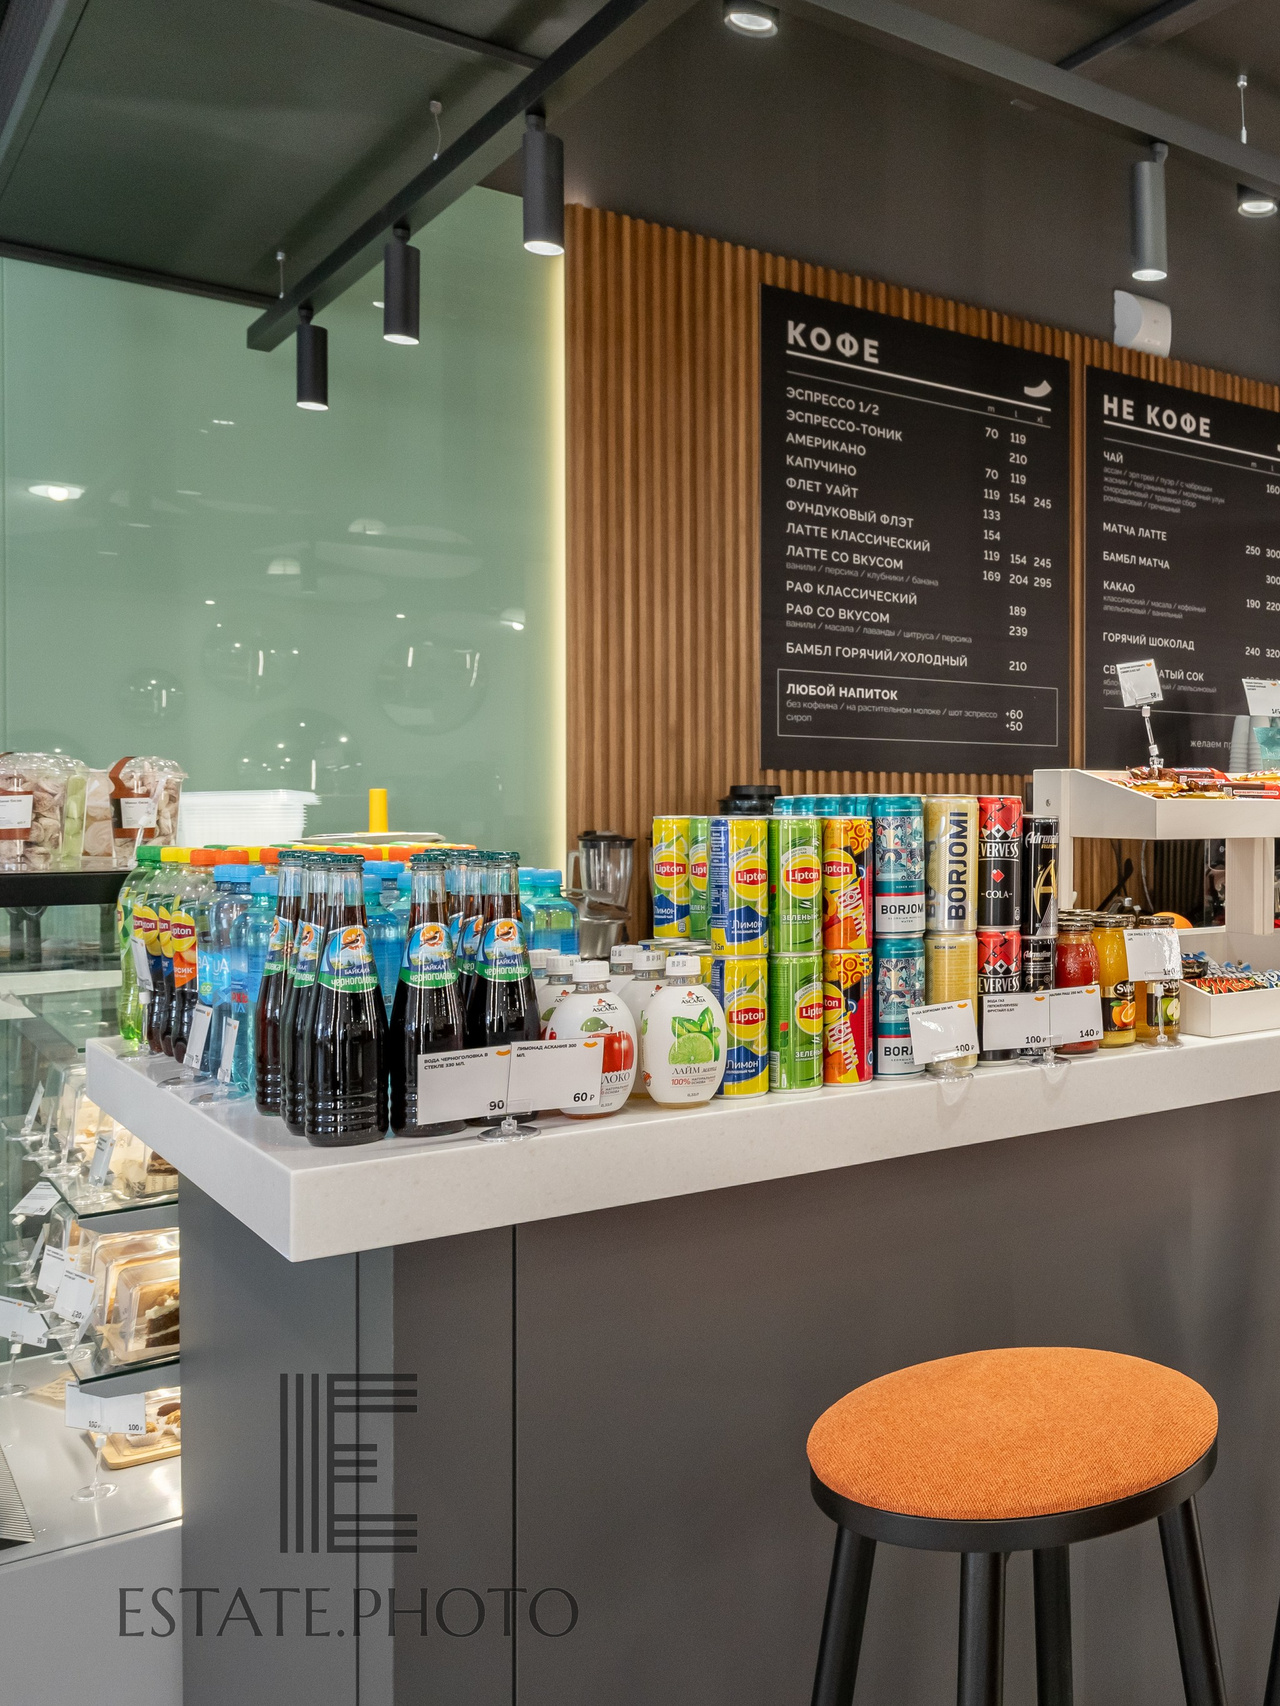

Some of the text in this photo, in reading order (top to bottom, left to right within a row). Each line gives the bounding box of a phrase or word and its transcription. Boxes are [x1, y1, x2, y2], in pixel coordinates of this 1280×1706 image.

[787, 320, 879, 364] КОФЕ
[786, 387, 1027, 445] ЭСПРЕССО 1/2 70 119
[1103, 394, 1211, 438] НЕ КОФЕ
[786, 409, 1028, 465] ЭСПРЕССО-ТОНИК 210
[786, 432, 1027, 486] АМЕРИКАНО 70 119
[1103, 450, 1124, 464] ЧАЙ
[1266, 484, 1280, 495] 160
[786, 454, 1052, 510] КАПУЧИНО 119 154 245
[786, 477, 1001, 522] ФЛЕТ УАЙТ 133
[786, 500, 1001, 542] ФУНДУКОВЫЙ ФЛЭТ 154
[786, 522, 1052, 569] ЛАТТЕ КЛАССИЧЕСКИЙ 119 154 245
[1103, 522, 1136, 536] МАТЧА
[1138, 527, 1167, 541] ЛАТТЕ
[1245, 545, 1261, 556] 250
[786, 545, 1052, 589] ЛАТТЕ СО ВКУСОМ 169 204 295
[1103, 551, 1136, 566] БАМБЛ
[1138, 556, 1170, 570] МАТЧА
[786, 562, 816, 573] ванили
[825, 566, 859, 579] персика
[912, 576, 939, 587] банана
[786, 580, 1027, 618] РАФ КЛАССИЧЕСКИЙ 189
[1103, 580, 1136, 594] КАКАО
[1246, 599, 1261, 610] 190
[1266, 601, 1280, 612] 220
[786, 603, 1028, 638] РАФ СО ВКУСОМ 239
[786, 620, 973, 644] ванили масала лаванды цитруса персика
[1103, 632, 1280, 659] ГОРЯЧИЙ ШОКОЛАД 240 320
[786, 642, 1027, 672] БАМБЛ ГОРЯЧИЙ/ХОЛОДНЫЙ 210
[1186, 671, 1205, 682] СОК
[786, 682, 898, 701] ЛЮБОЙ НАПИТОК
[786, 699, 1023, 721] без кофеина на растительном молоке шот эспрессо +60
[786, 713, 1023, 732] сироп +50
[1190, 738, 1222, 751] желаем
[656, 864, 683, 874] Lipton
[692, 865, 707, 874] Lipt
[947, 812, 968, 920] BORJOMI
[738, 872, 767, 882] Lipton
[789, 870, 819, 882] Lipton
[881, 903, 924, 915] BORJOM
[731, 919, 763, 930] Лимон
[978, 976, 1020, 993] EVERVESS
[592, 1005, 619, 1014] ASCANIA
[680, 997, 707, 1005] ASCANIA
[732, 1011, 764, 1023] Lipton
[802, 1007, 823, 1018] Lipto
[1025, 1036, 1042, 1044] 100
[1080, 1028, 1095, 1038] 140
[516, 1044, 543, 1052] ЛИМОНАД
[884, 1046, 913, 1057] BORJ
[441, 1054, 483, 1062] ЧЕРНОГОЛОВКА
[726, 1060, 758, 1069] Лимон
[601, 1072, 631, 1085] ЛОКО
[671, 1065, 700, 1075] ЛАЙМ
[671, 1078, 691, 1086] 100%
[489, 1099, 505, 1111] 90
[573, 1092, 588, 1103] 60
